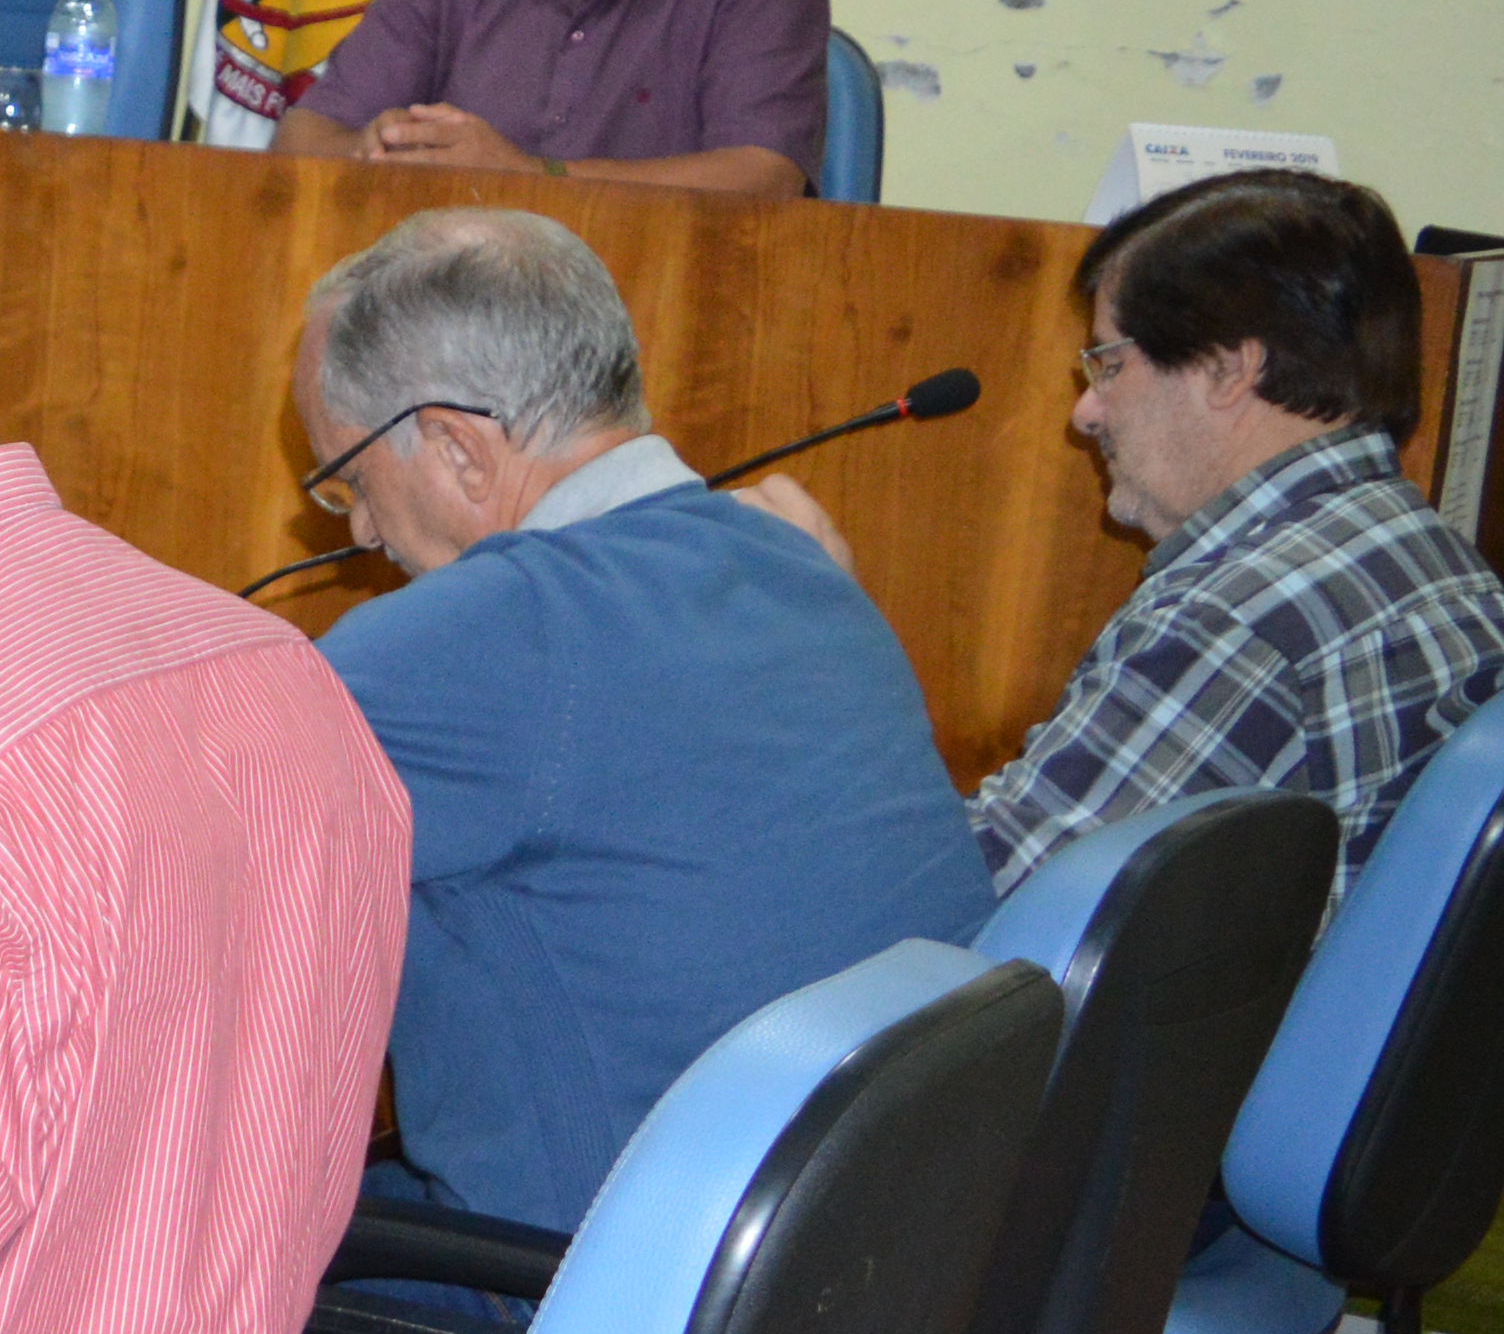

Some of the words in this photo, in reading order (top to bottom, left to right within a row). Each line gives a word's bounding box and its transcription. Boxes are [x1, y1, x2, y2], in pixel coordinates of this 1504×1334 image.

[218, 64, 266, 107] MAIS
[1145, 143, 1190, 156] CAIXA
[1223, 148, 1287, 163] FEVEREIRO
[1290, 152, 1319, 165] 2019
